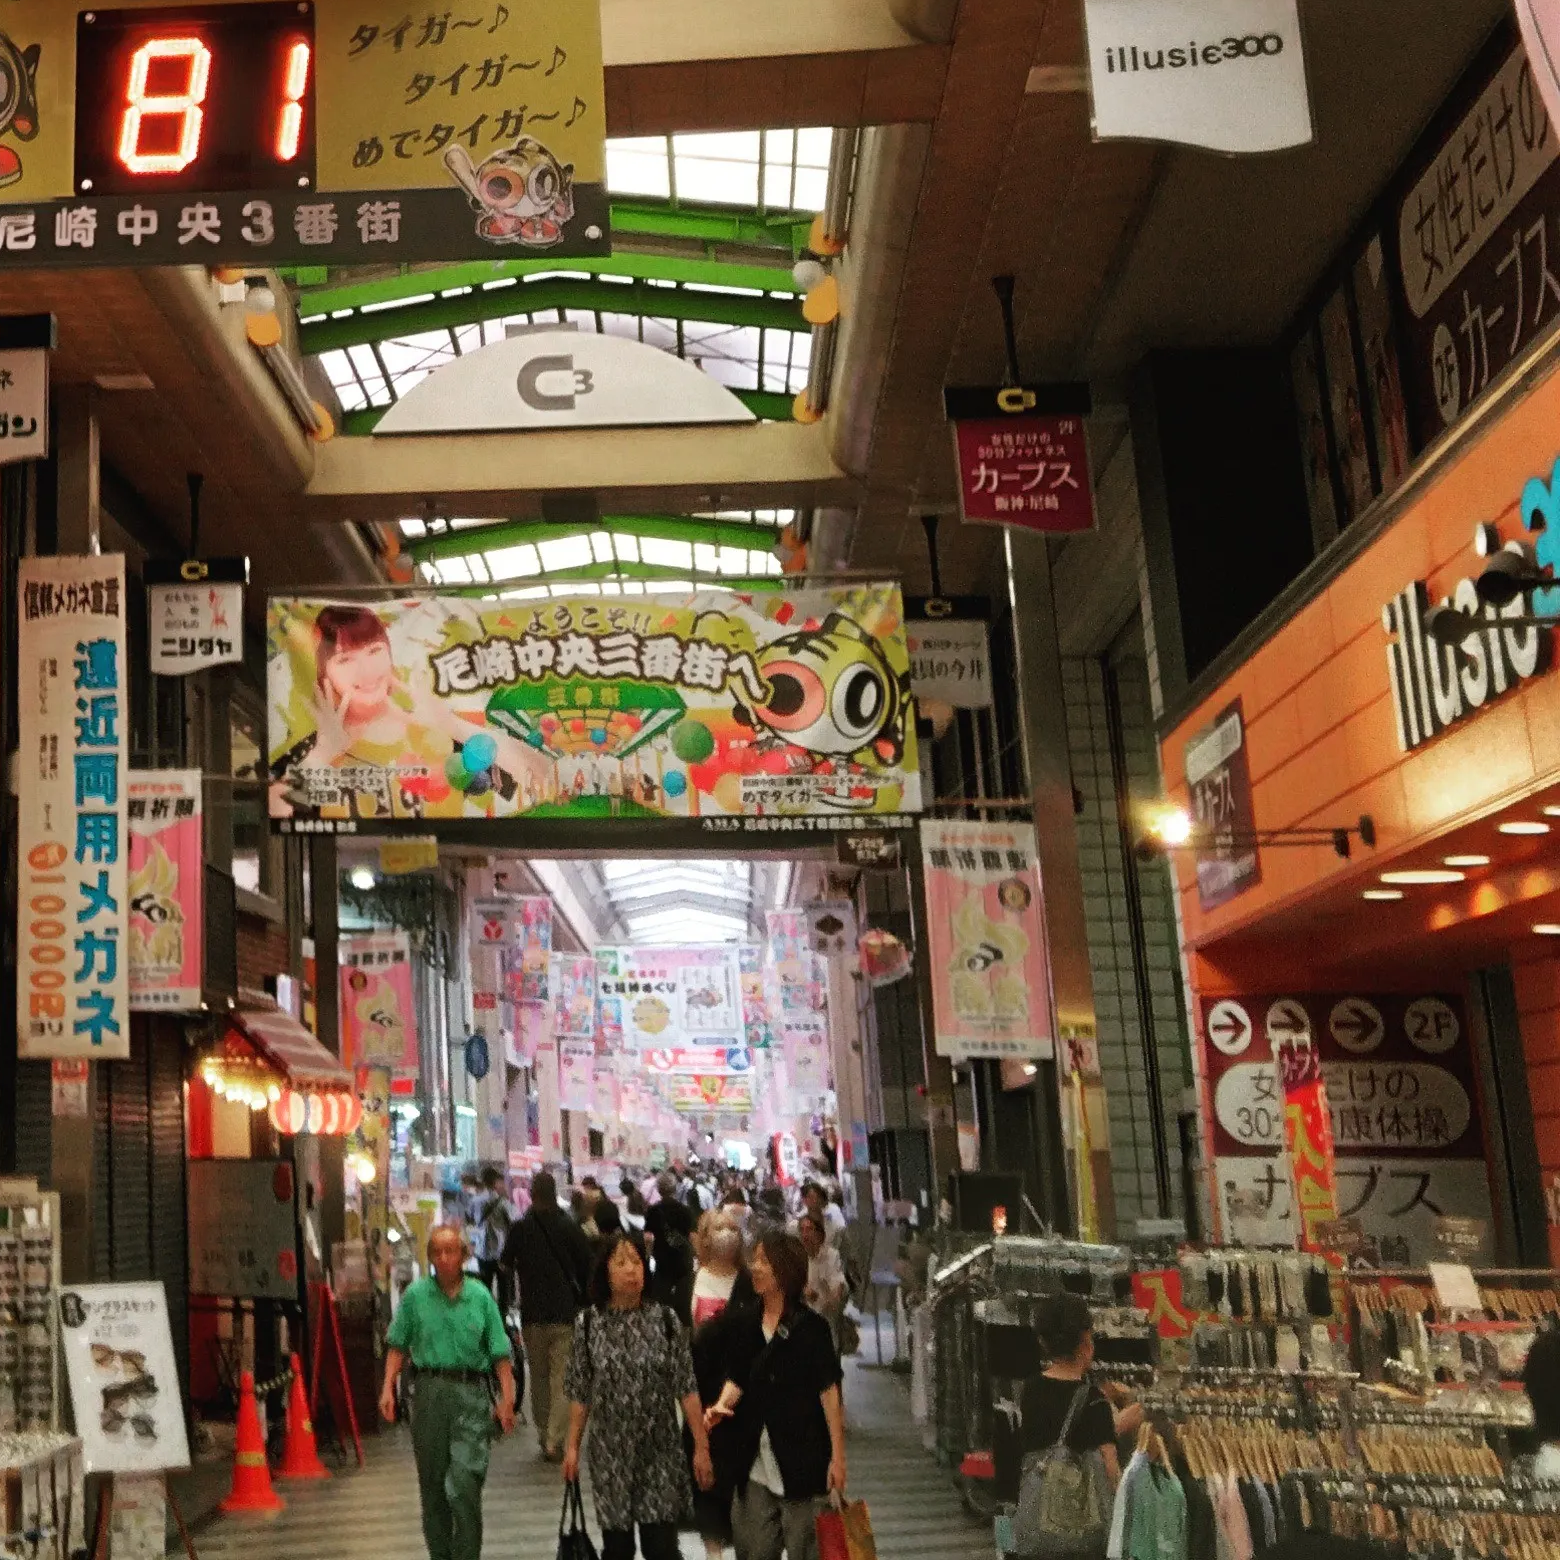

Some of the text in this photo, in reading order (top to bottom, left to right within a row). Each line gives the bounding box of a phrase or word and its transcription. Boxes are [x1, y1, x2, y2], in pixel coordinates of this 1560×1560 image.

[430, 630, 773, 708] 尼崎中央三番街へ
[72, 637, 121, 1047] 遠近両用メガネ
